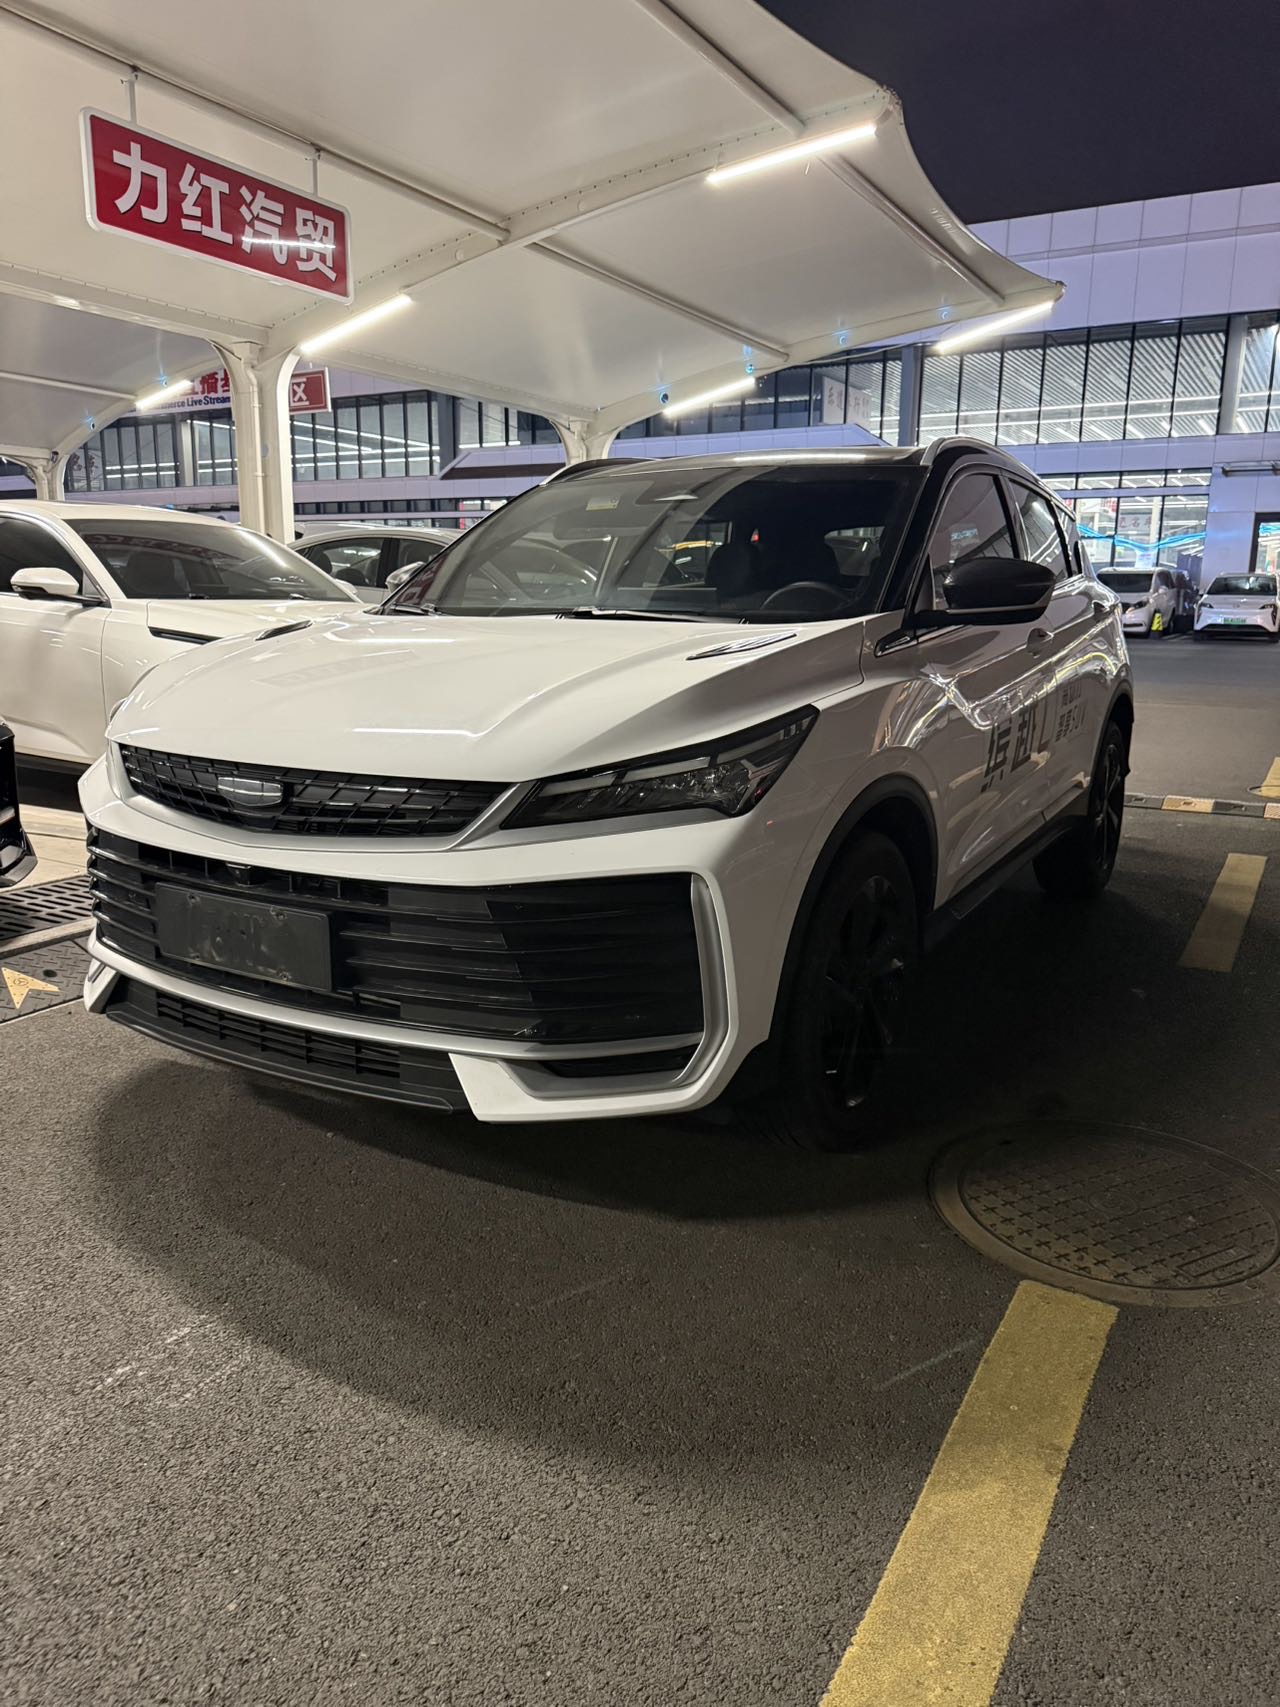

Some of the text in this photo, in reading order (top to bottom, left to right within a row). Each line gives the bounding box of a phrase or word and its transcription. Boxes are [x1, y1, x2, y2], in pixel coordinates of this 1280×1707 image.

[112, 141, 337, 282] 力红汽贸
[187, 396, 203, 407] Live
